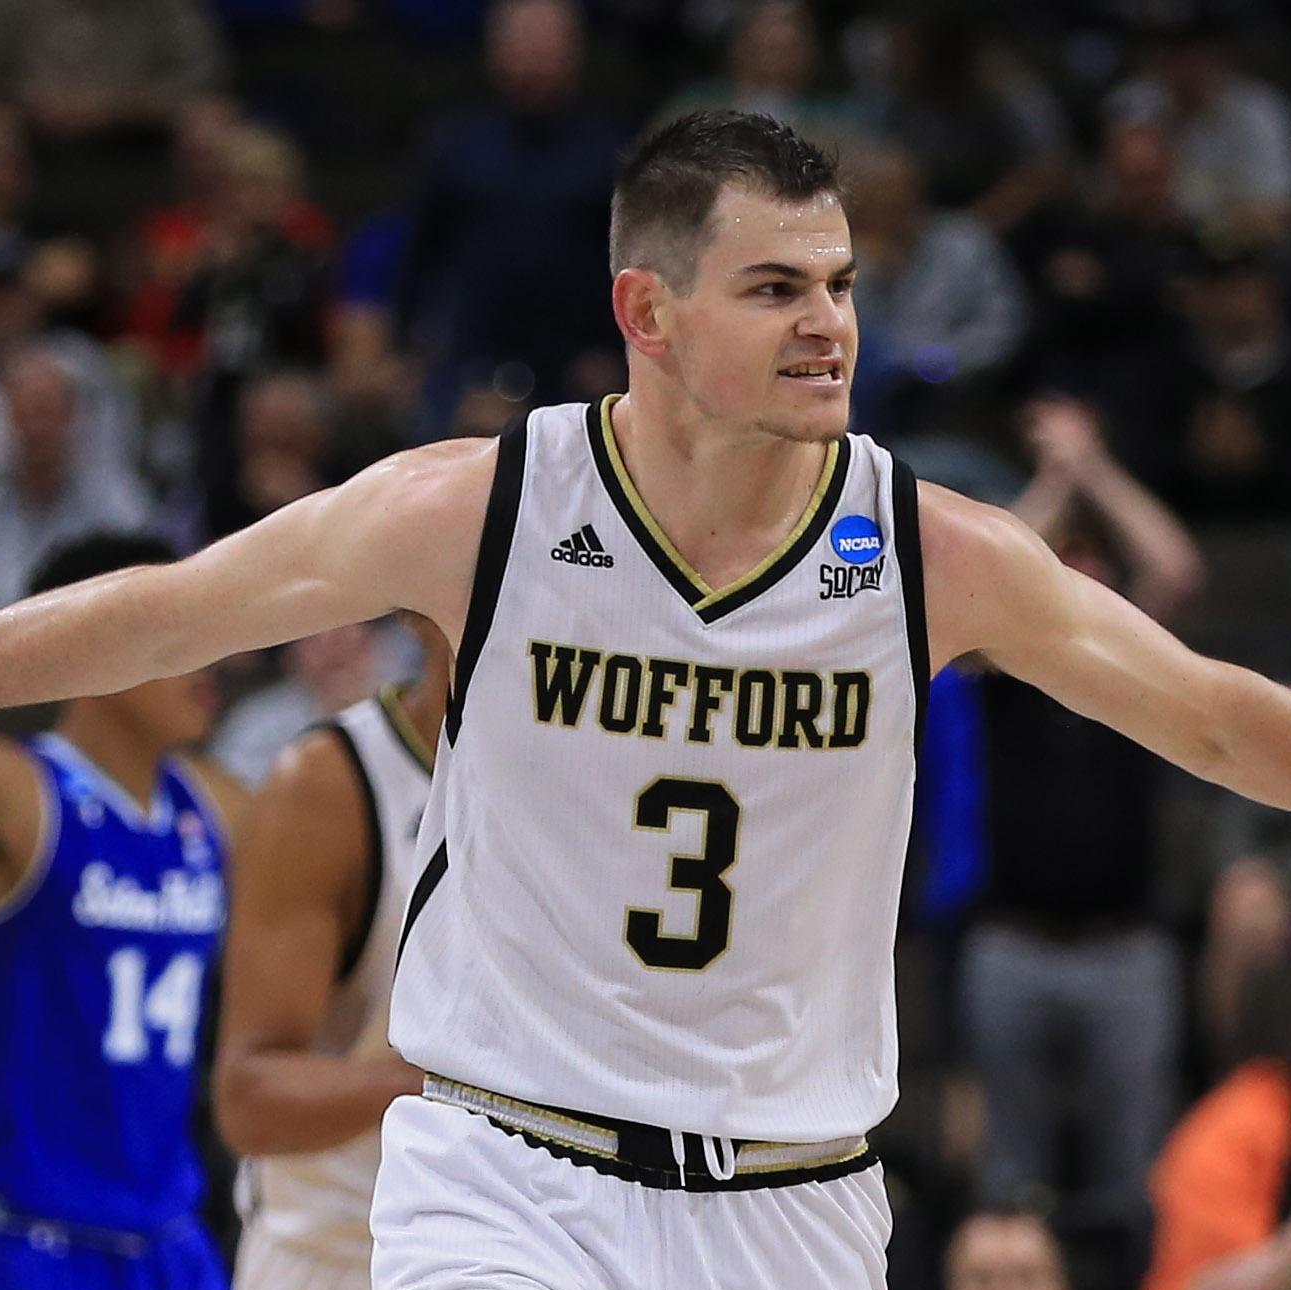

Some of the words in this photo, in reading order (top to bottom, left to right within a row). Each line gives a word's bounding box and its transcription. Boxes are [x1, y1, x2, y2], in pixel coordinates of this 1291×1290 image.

[551, 548, 614, 568] adidas
[839, 536, 880, 552] NCAA
[528, 640, 872, 750] WOFFORD
[625, 775, 741, 972] 3
[102, 946, 204, 1068] 14
